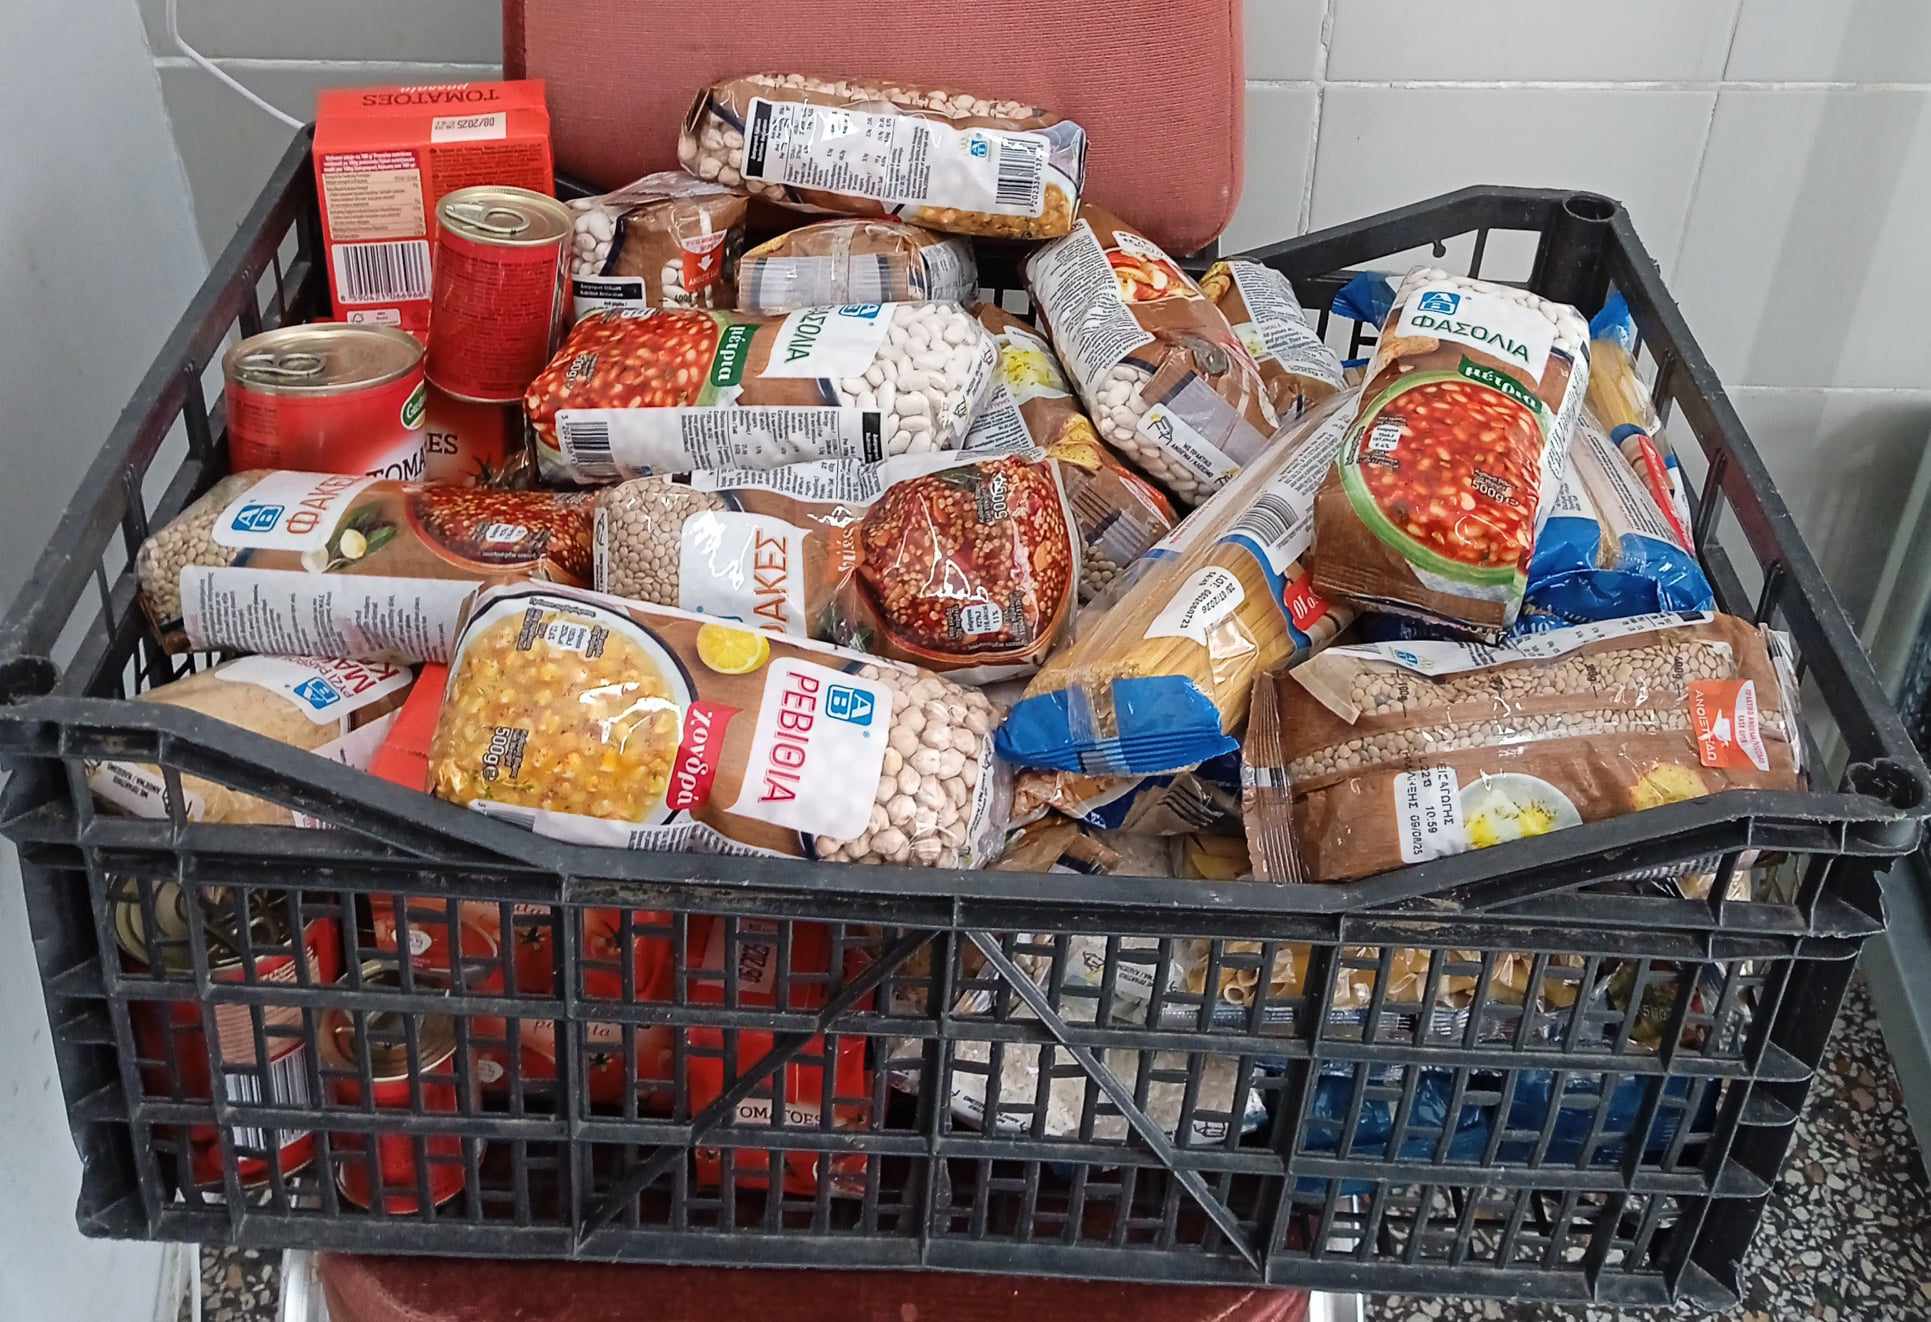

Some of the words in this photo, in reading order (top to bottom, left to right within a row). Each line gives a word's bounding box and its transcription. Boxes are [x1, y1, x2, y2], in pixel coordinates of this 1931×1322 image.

[362, 86, 500, 107] TOMATOES
[1411, 314, 1530, 362] ΦΑΣΟΛΙΑ
[1465, 366, 1537, 411] μέτρια
[754, 528, 788, 633] ΑΚΕΣ
[757, 671, 820, 803] ΡΕΒΙΘΙΑ
[1425, 805, 1439, 835] 10:59
